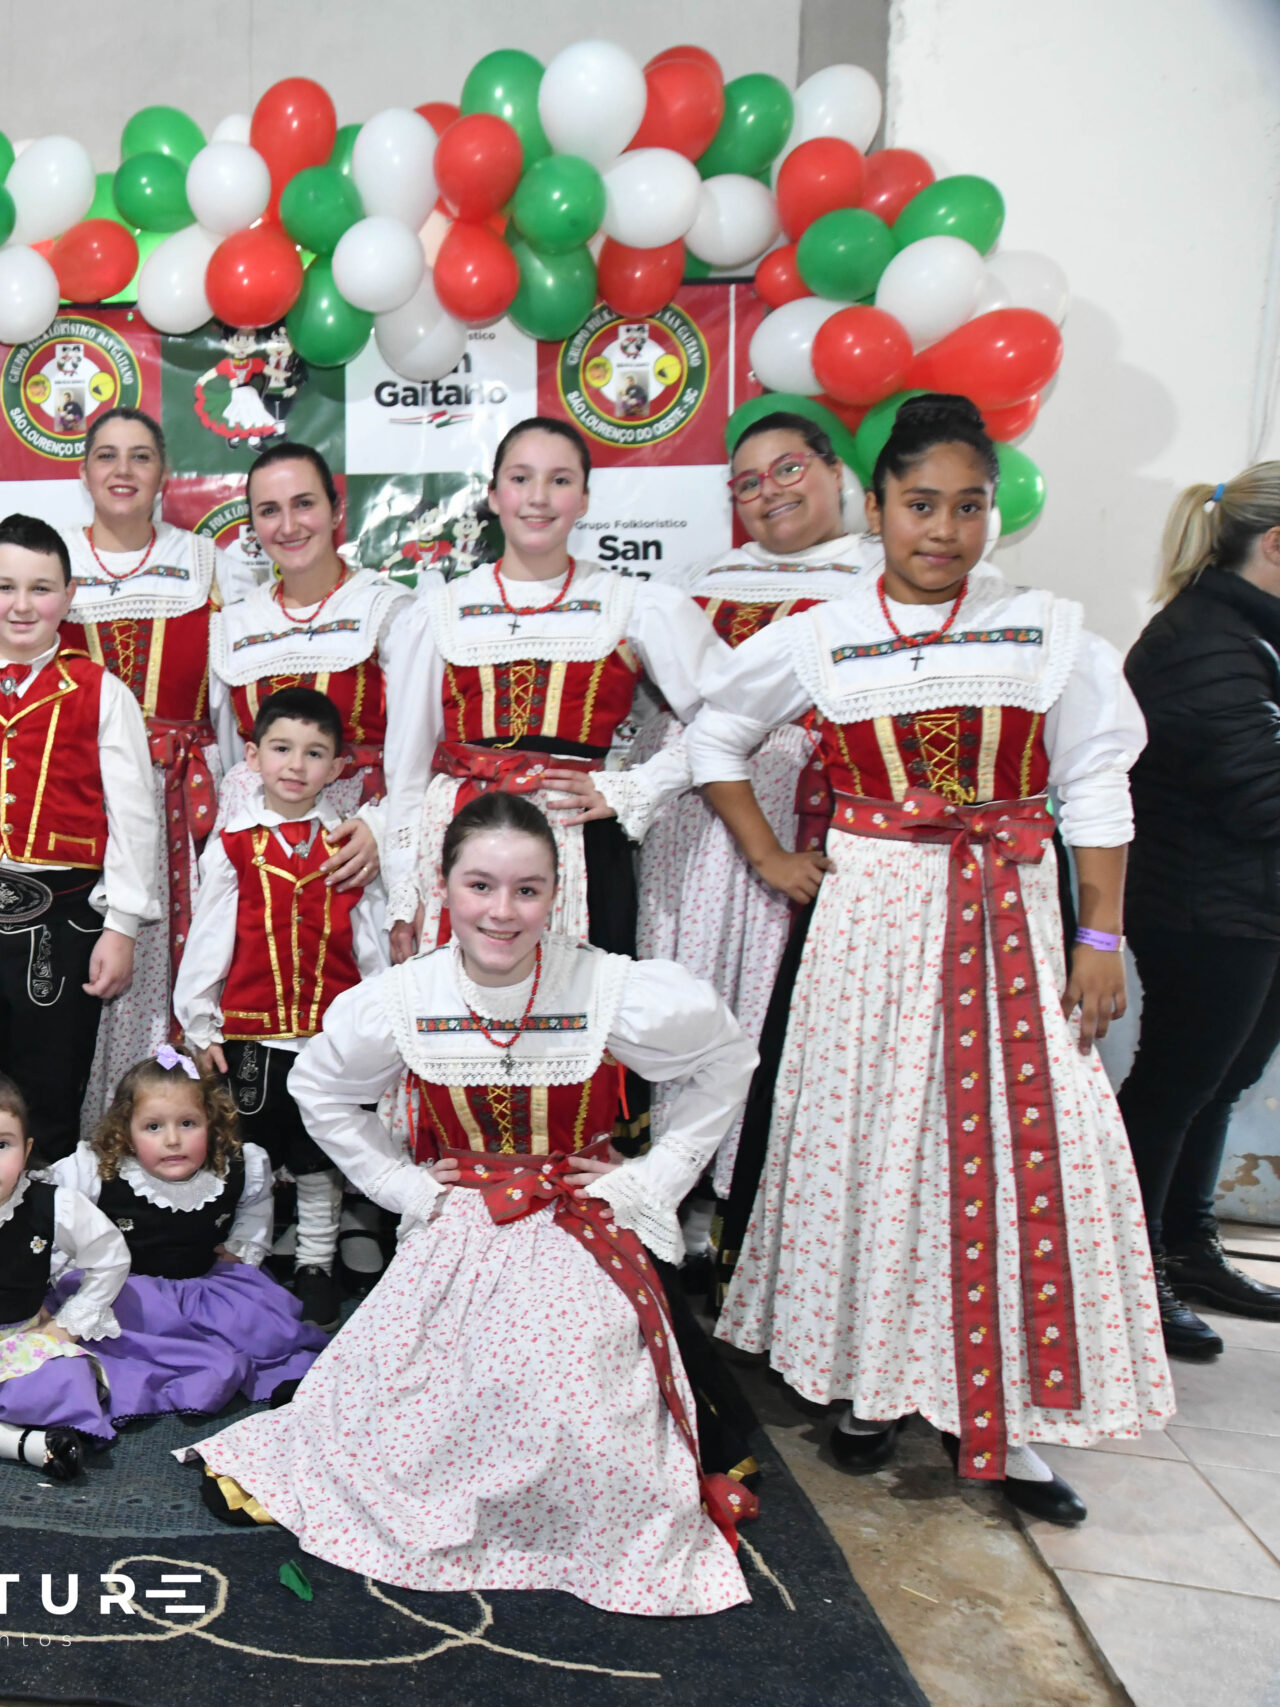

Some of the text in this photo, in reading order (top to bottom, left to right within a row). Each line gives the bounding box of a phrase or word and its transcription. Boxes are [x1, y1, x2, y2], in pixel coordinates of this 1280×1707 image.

[635, 426, 653, 442] DO
[652, 406, 687, 436] OESTE
[683, 387, 699, 405] SC
[22, 426, 73, 457] LOURENÇO
[575, 520, 611, 531] Grupo
[598, 534, 663, 561] San
